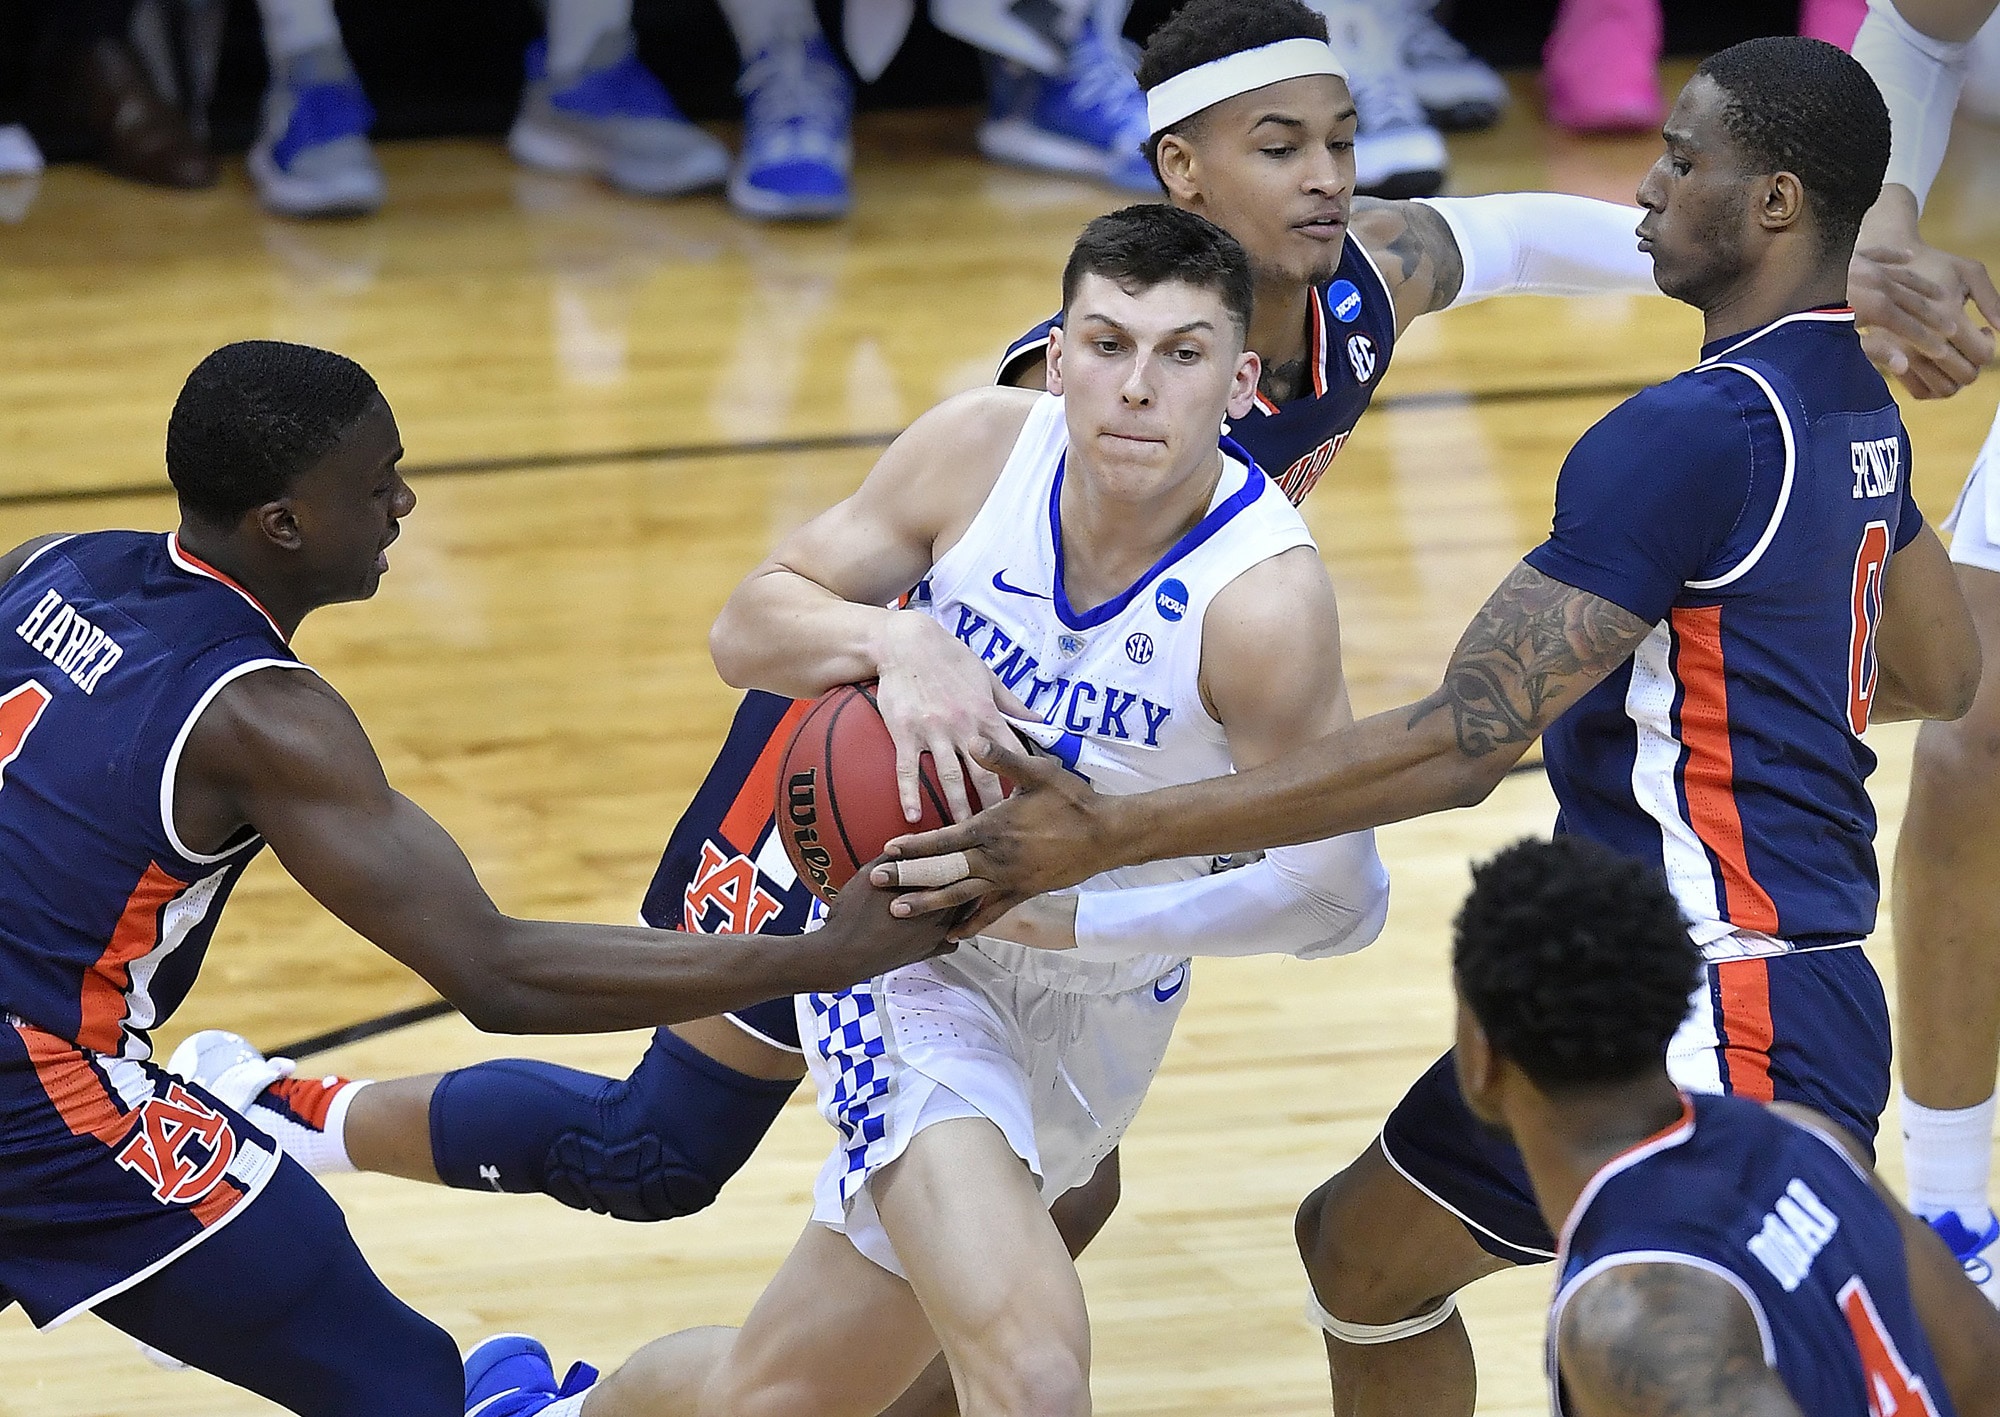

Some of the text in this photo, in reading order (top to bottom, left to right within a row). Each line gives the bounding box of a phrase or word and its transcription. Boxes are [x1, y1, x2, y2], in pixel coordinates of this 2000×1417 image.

[1335, 290, 1361, 319] NCAA
[1850, 436, 1901, 499] SPENCE
[1156, 592, 1187, 617] NCAA
[1847, 519, 1889, 740] 0
[15, 587, 125, 696] HARPER
[1125, 633, 1154, 664] SEC
[788, 766, 842, 900] Wils
